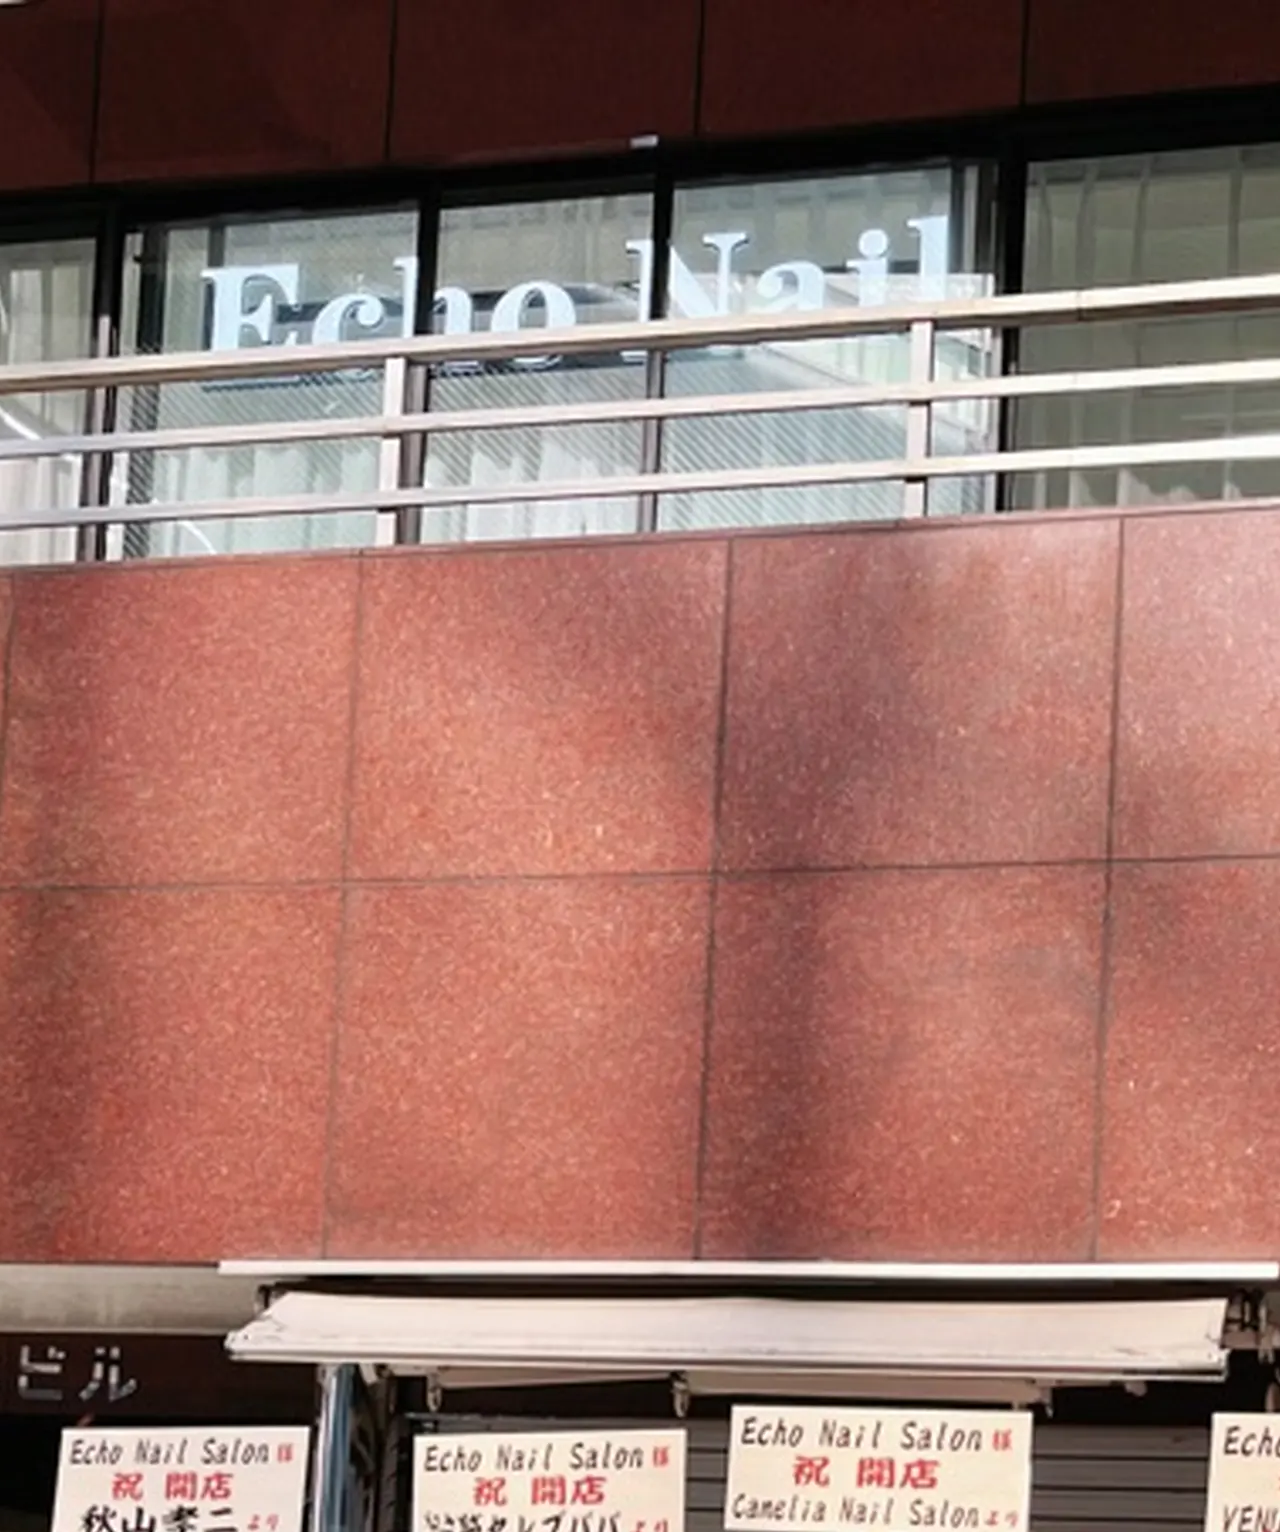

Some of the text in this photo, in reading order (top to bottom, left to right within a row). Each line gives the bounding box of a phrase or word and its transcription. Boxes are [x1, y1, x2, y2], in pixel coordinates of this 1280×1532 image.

[200, 215, 950, 372] Echo Nail
[739, 1415, 804, 1449] Echo
[818, 1419, 882, 1450] Nail
[900, 1420, 983, 1452] Salon
[68, 1438, 122, 1466] Echo
[135, 1437, 188, 1466] Nail
[201, 1437, 270, 1466] Salon
[423, 1445, 483, 1473] Echo
[495, 1443, 554, 1473] Nail
[568, 1441, 645, 1471] Salon
[111, 1471, 235, 1501] 祝 開店
[792, 1455, 940, 1489] 祝 開店
[472, 1474, 608, 1508] 祝 開店
[731, 1492, 827, 1523] Camelia
[838, 1496, 895, 1526] Nail
[909, 1499, 980, 1529] Salon
